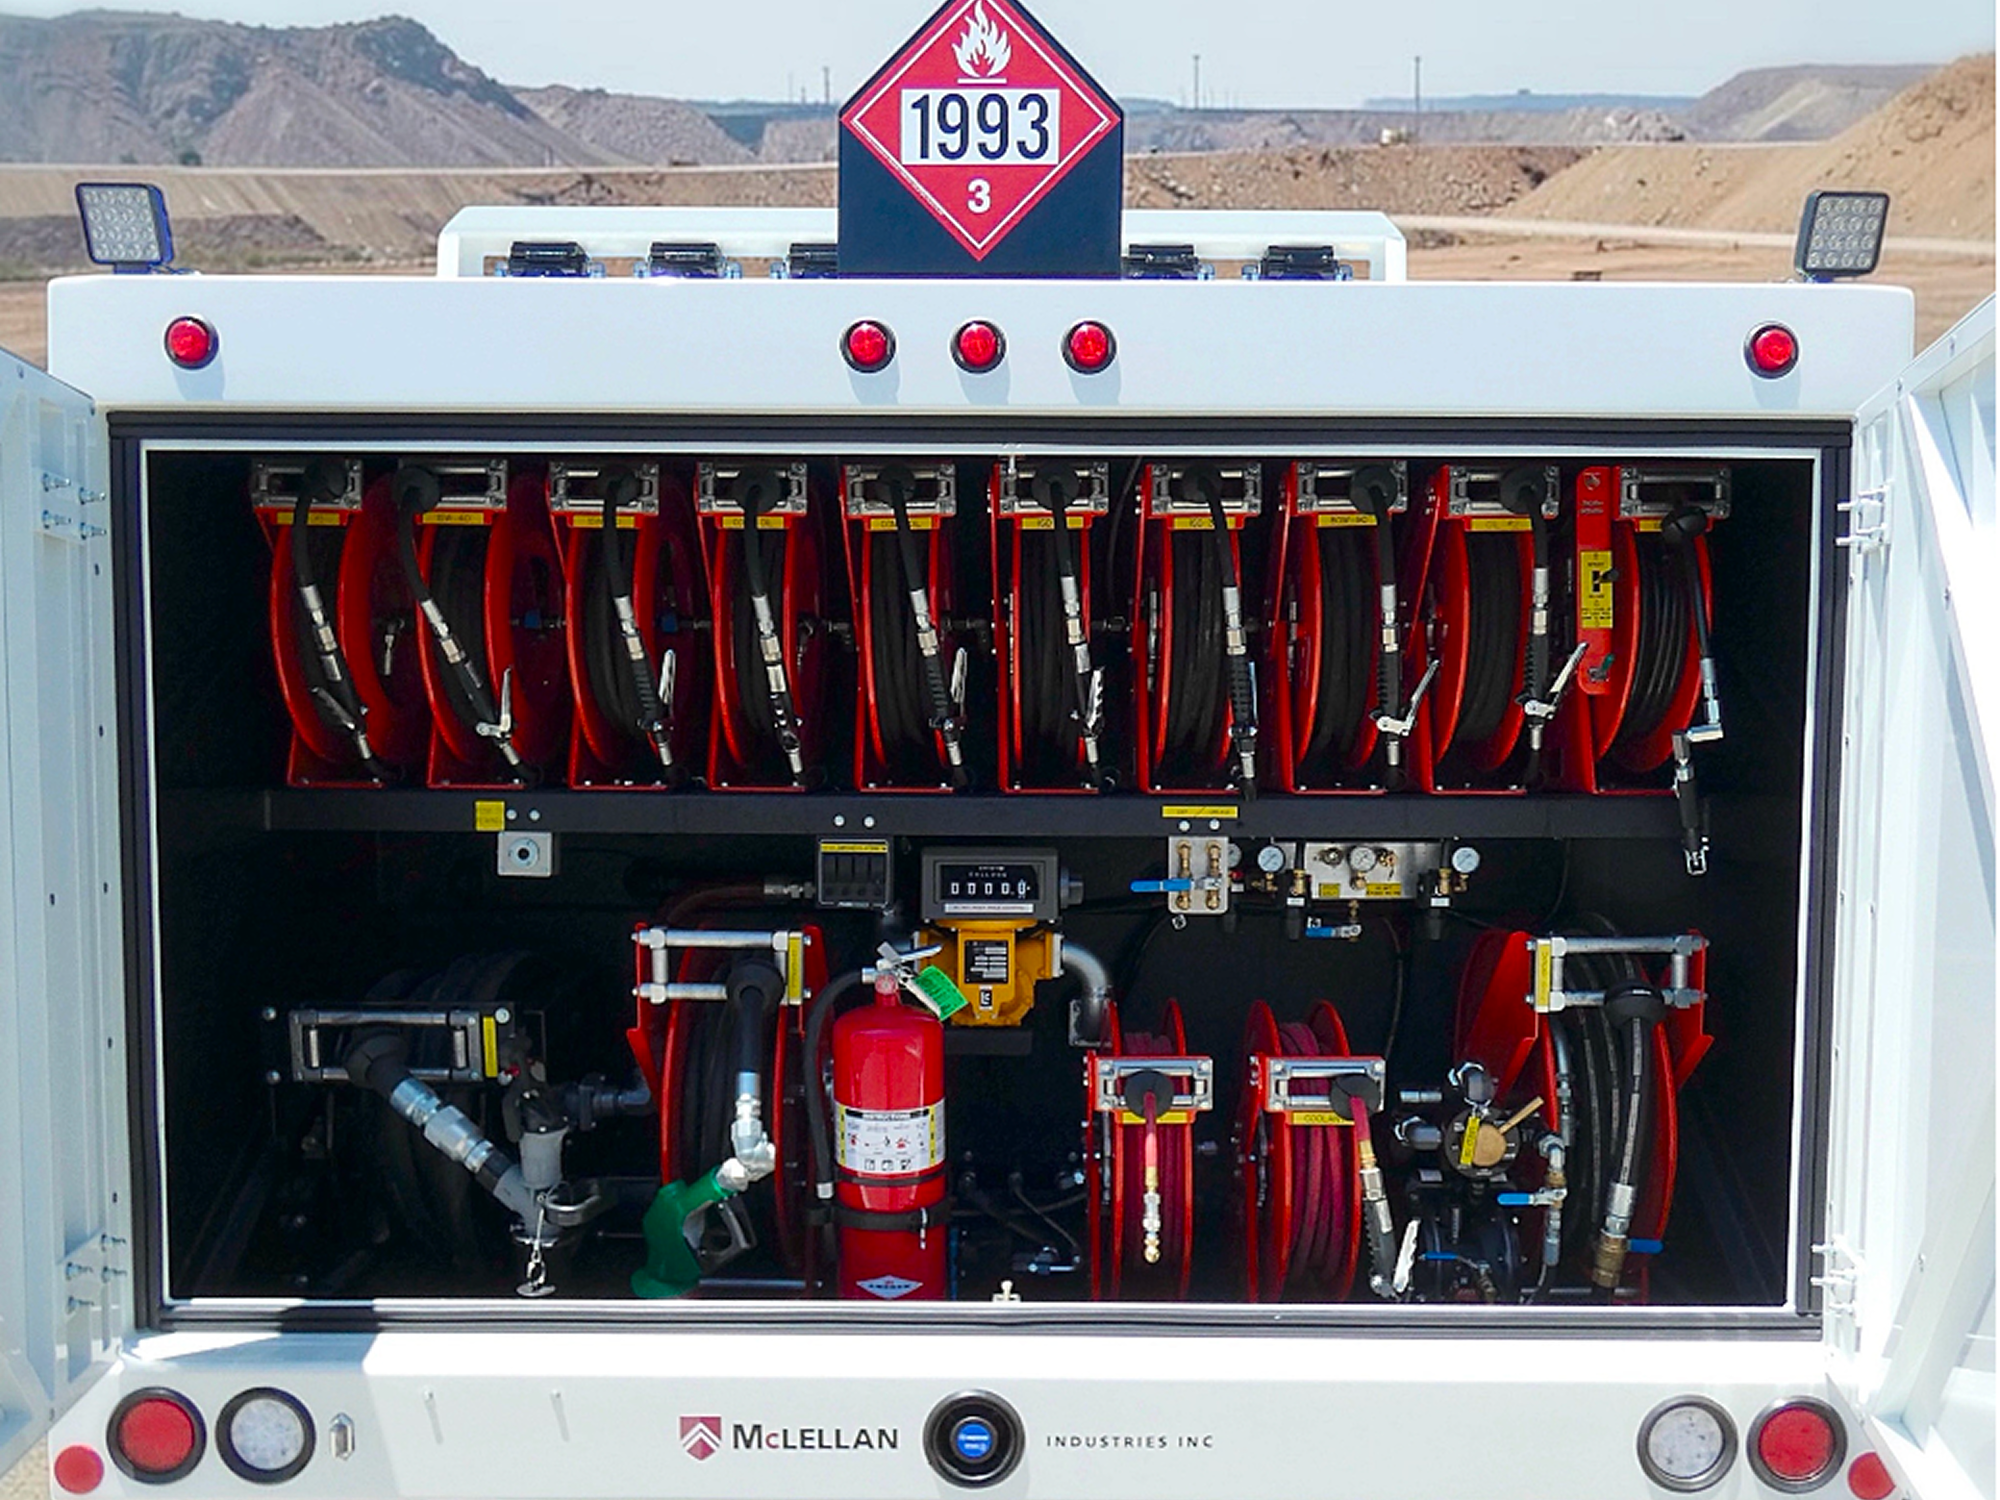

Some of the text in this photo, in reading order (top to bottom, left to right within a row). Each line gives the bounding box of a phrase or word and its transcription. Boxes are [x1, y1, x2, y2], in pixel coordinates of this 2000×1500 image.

[911, 93, 1049, 160] 1993
[967, 178, 991, 213] 3
[1047, 1435, 1168, 1448] INDUSTRIES
[1178, 1435, 1213, 1448] INC
